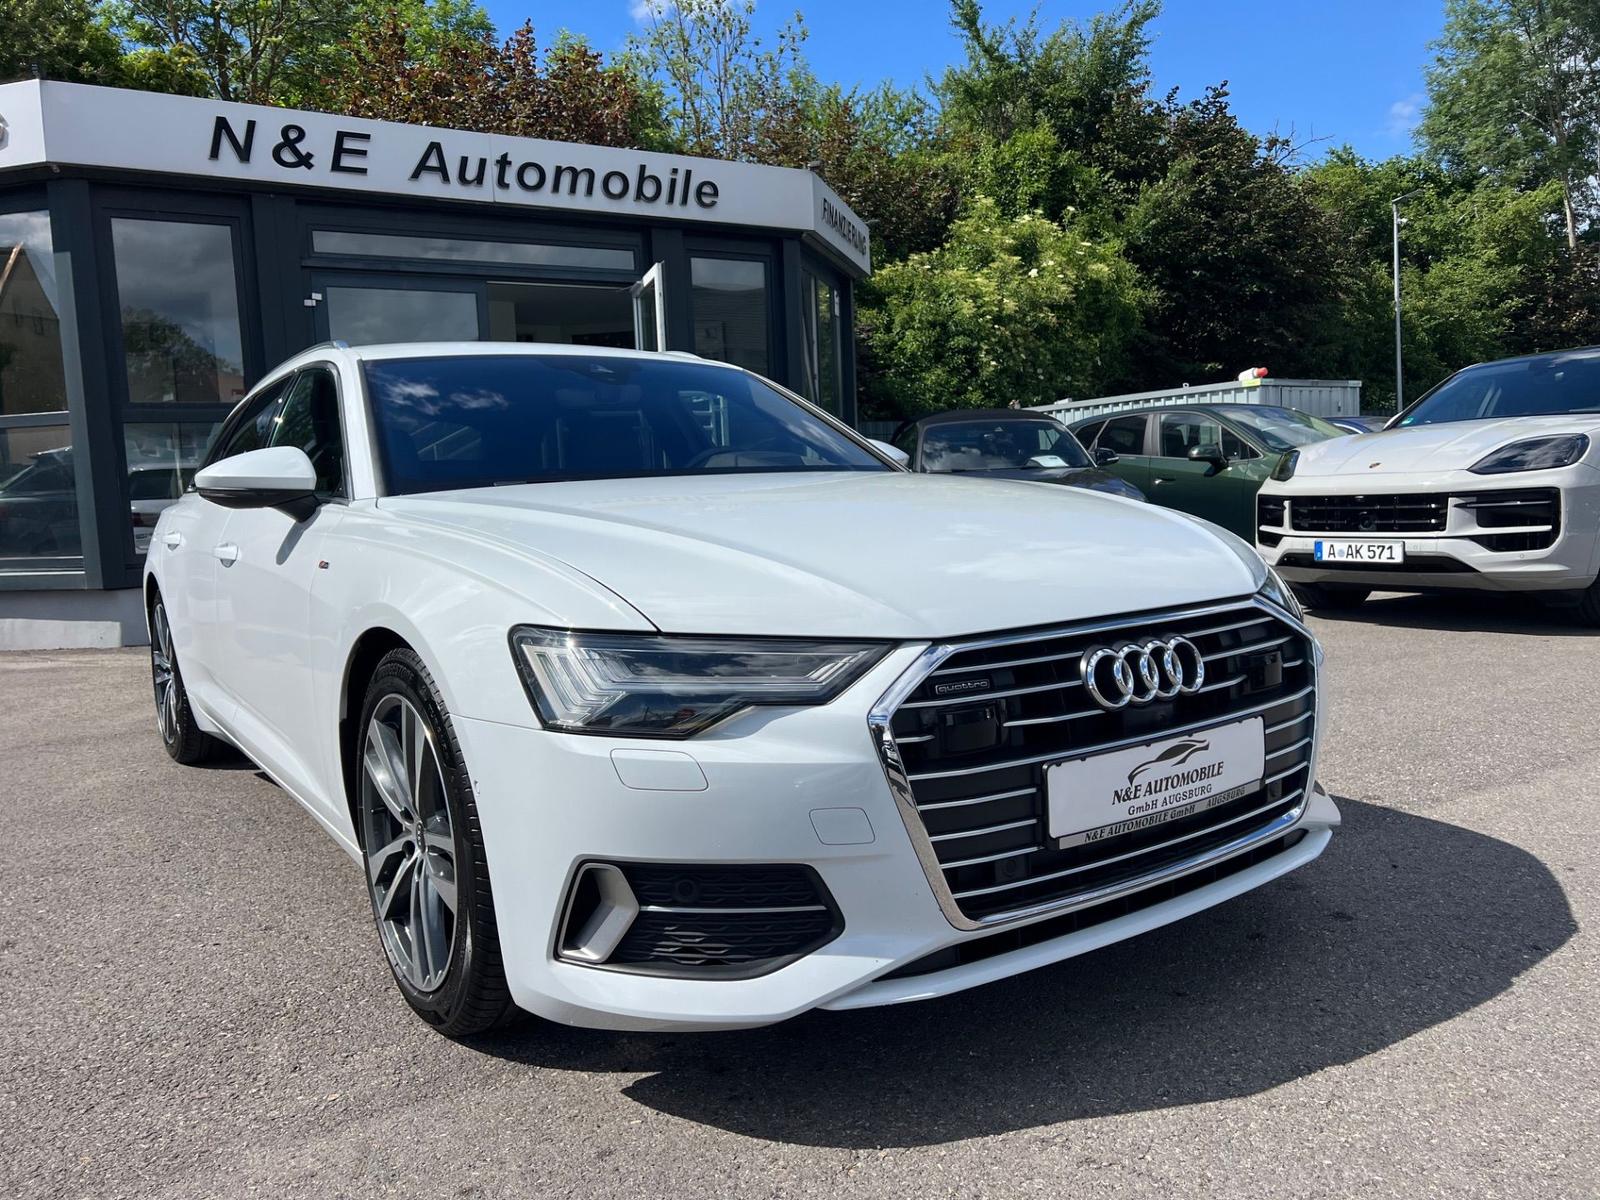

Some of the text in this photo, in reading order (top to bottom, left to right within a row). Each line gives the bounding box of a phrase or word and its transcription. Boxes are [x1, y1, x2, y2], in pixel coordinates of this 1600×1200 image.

[408, 141, 720, 209] Automobile
[1367, 545, 1395, 560] 571
[938, 681, 988, 693] quattro
[1112, 761, 1224, 805] N&E AUTOMOBILE
[1128, 784, 1213, 816] GmbH AUGSBURG
[1084, 787, 1246, 842] N&E AUTOMOBILE GmbH AUGSBURG
